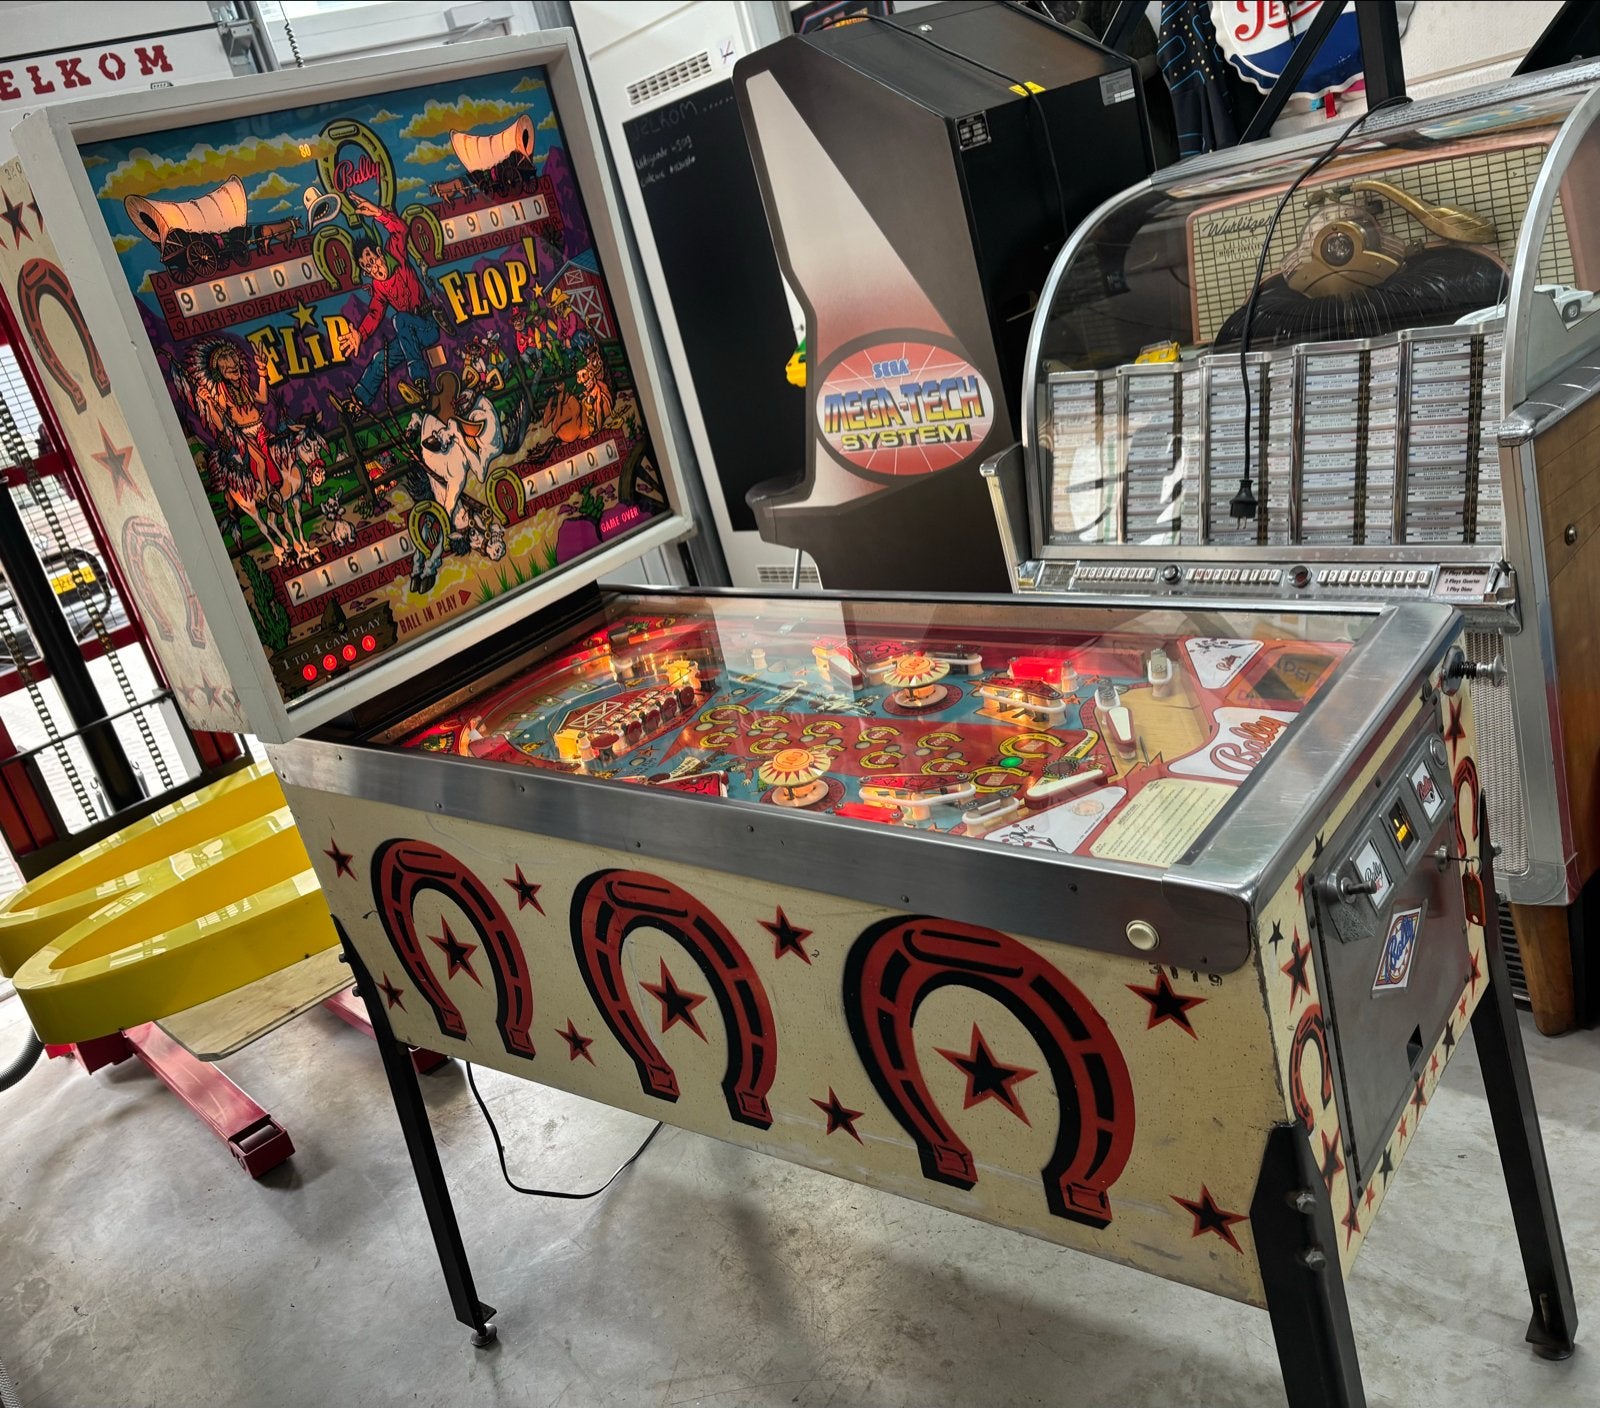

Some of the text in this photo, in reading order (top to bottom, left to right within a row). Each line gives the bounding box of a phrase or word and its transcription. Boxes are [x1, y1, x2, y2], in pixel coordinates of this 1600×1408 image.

[299, 144, 312, 158] 80
[334, 159, 381, 193] Bally
[418, 234, 431, 251] UP
[334, 257, 347, 275] UP
[439, 237, 541, 326] FLOP!
[872, 358, 910, 379] SEGA
[824, 375, 985, 433] MEGA-TECH
[841, 422, 972, 451] SYSTEM
[601, 507, 639, 533] GAME OVER
[399, 595, 457, 634] BALL IN PLAY
[293, 652, 309, 666] TO
[312, 643, 322, 655] 4
[325, 633, 349, 651] CAN
[352, 616, 382, 638] PLAY
[1209, 715, 1291, 775] Bally
